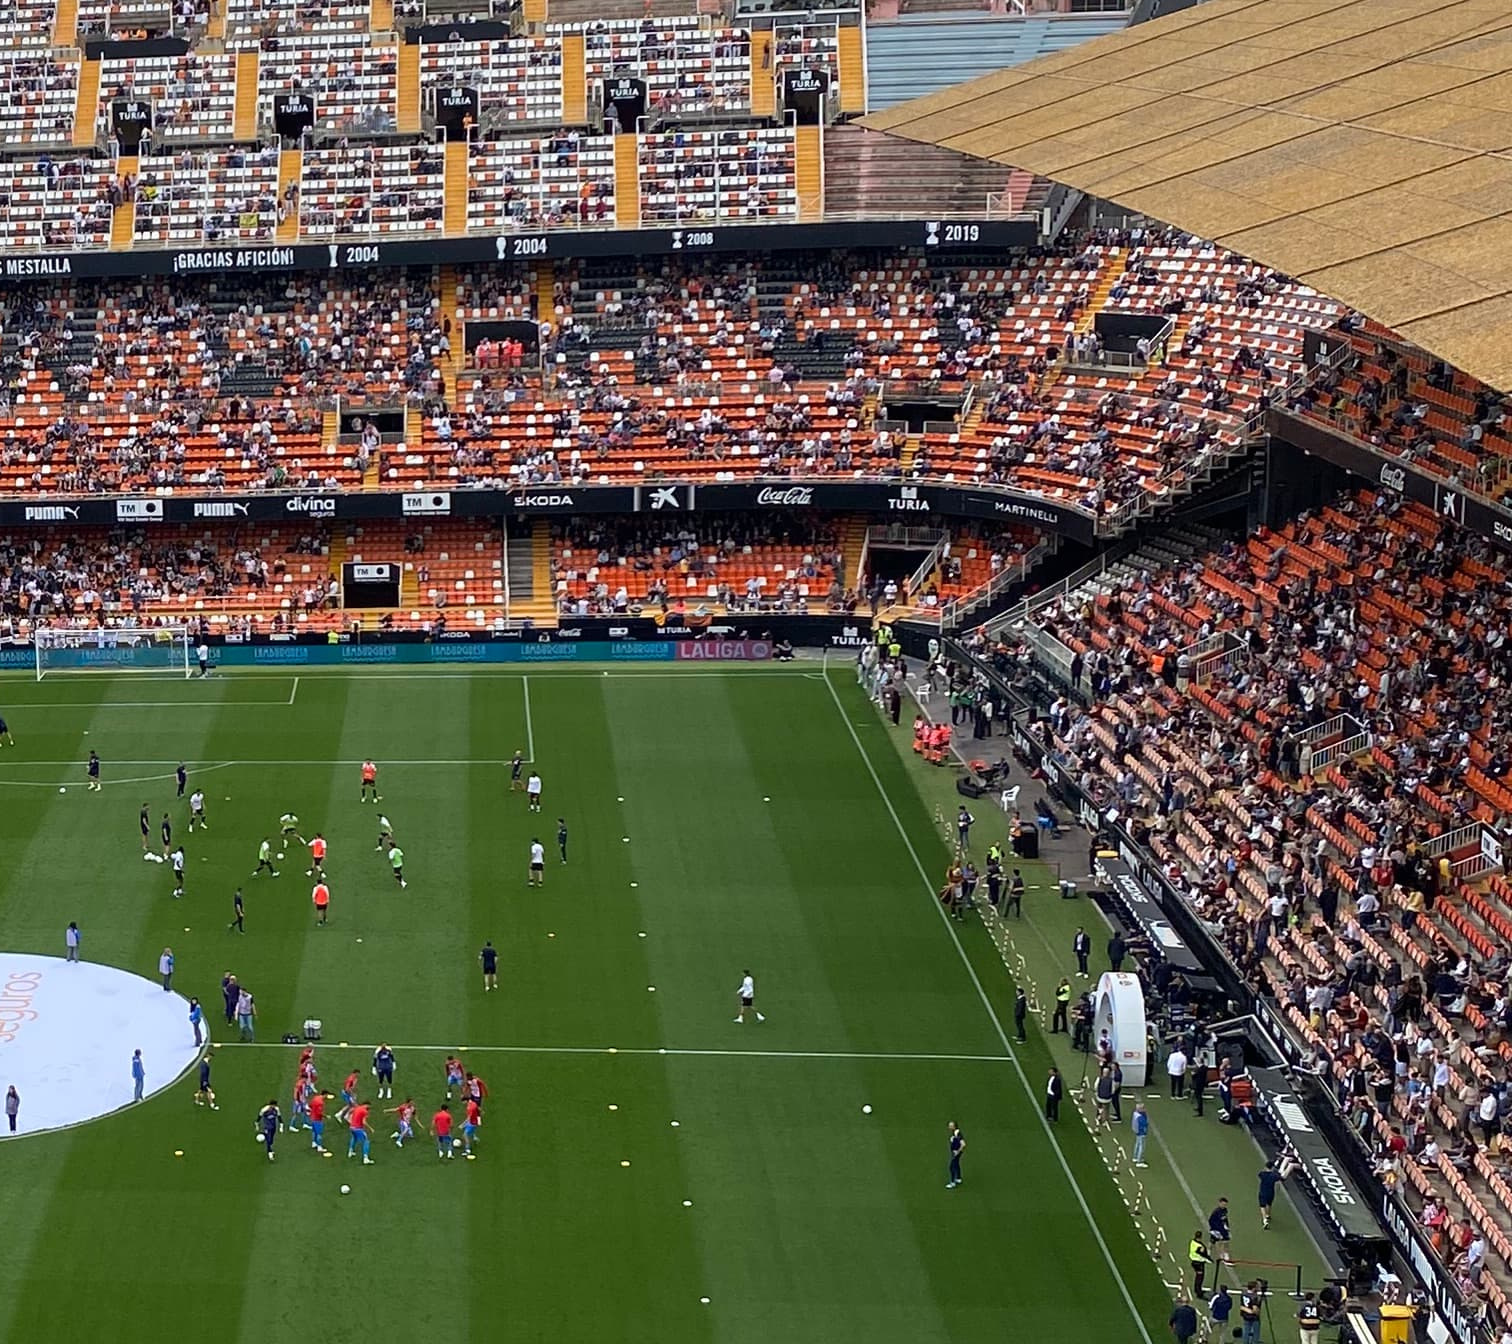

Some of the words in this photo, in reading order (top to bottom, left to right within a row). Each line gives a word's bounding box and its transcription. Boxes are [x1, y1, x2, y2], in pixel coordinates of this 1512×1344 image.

[791, 79, 821, 89] TURIA
[610, 88, 639, 97] TURIA
[442, 97, 471, 106] TURIA
[280, 104, 308, 113] TURIA
[119, 111, 146, 121] TURIA
[687, 232, 714, 245] 2008
[945, 225, 979, 241] 2019
[513, 239, 547, 254] 2004
[173, 253, 233, 273] ¡GRACIAS
[236, 248, 294, 268] AFICIÓN!
[346, 247, 379, 263] 2004
[6, 258, 71, 275] MESTALLA
[286, 496, 335, 511] divina
[406, 498, 422, 507] TM
[888, 499, 930, 510] TURIA
[120, 504, 135, 513] TM
[994, 501, 1058, 523] MARTINELLI
[356, 568, 369, 576] TM
[831, 636, 868, 645] TURIA
[680, 642, 745, 658] LALIGA
[1383, 1194, 1410, 1253] LALIGA
[1305, 1307, 1317, 1318] 34
